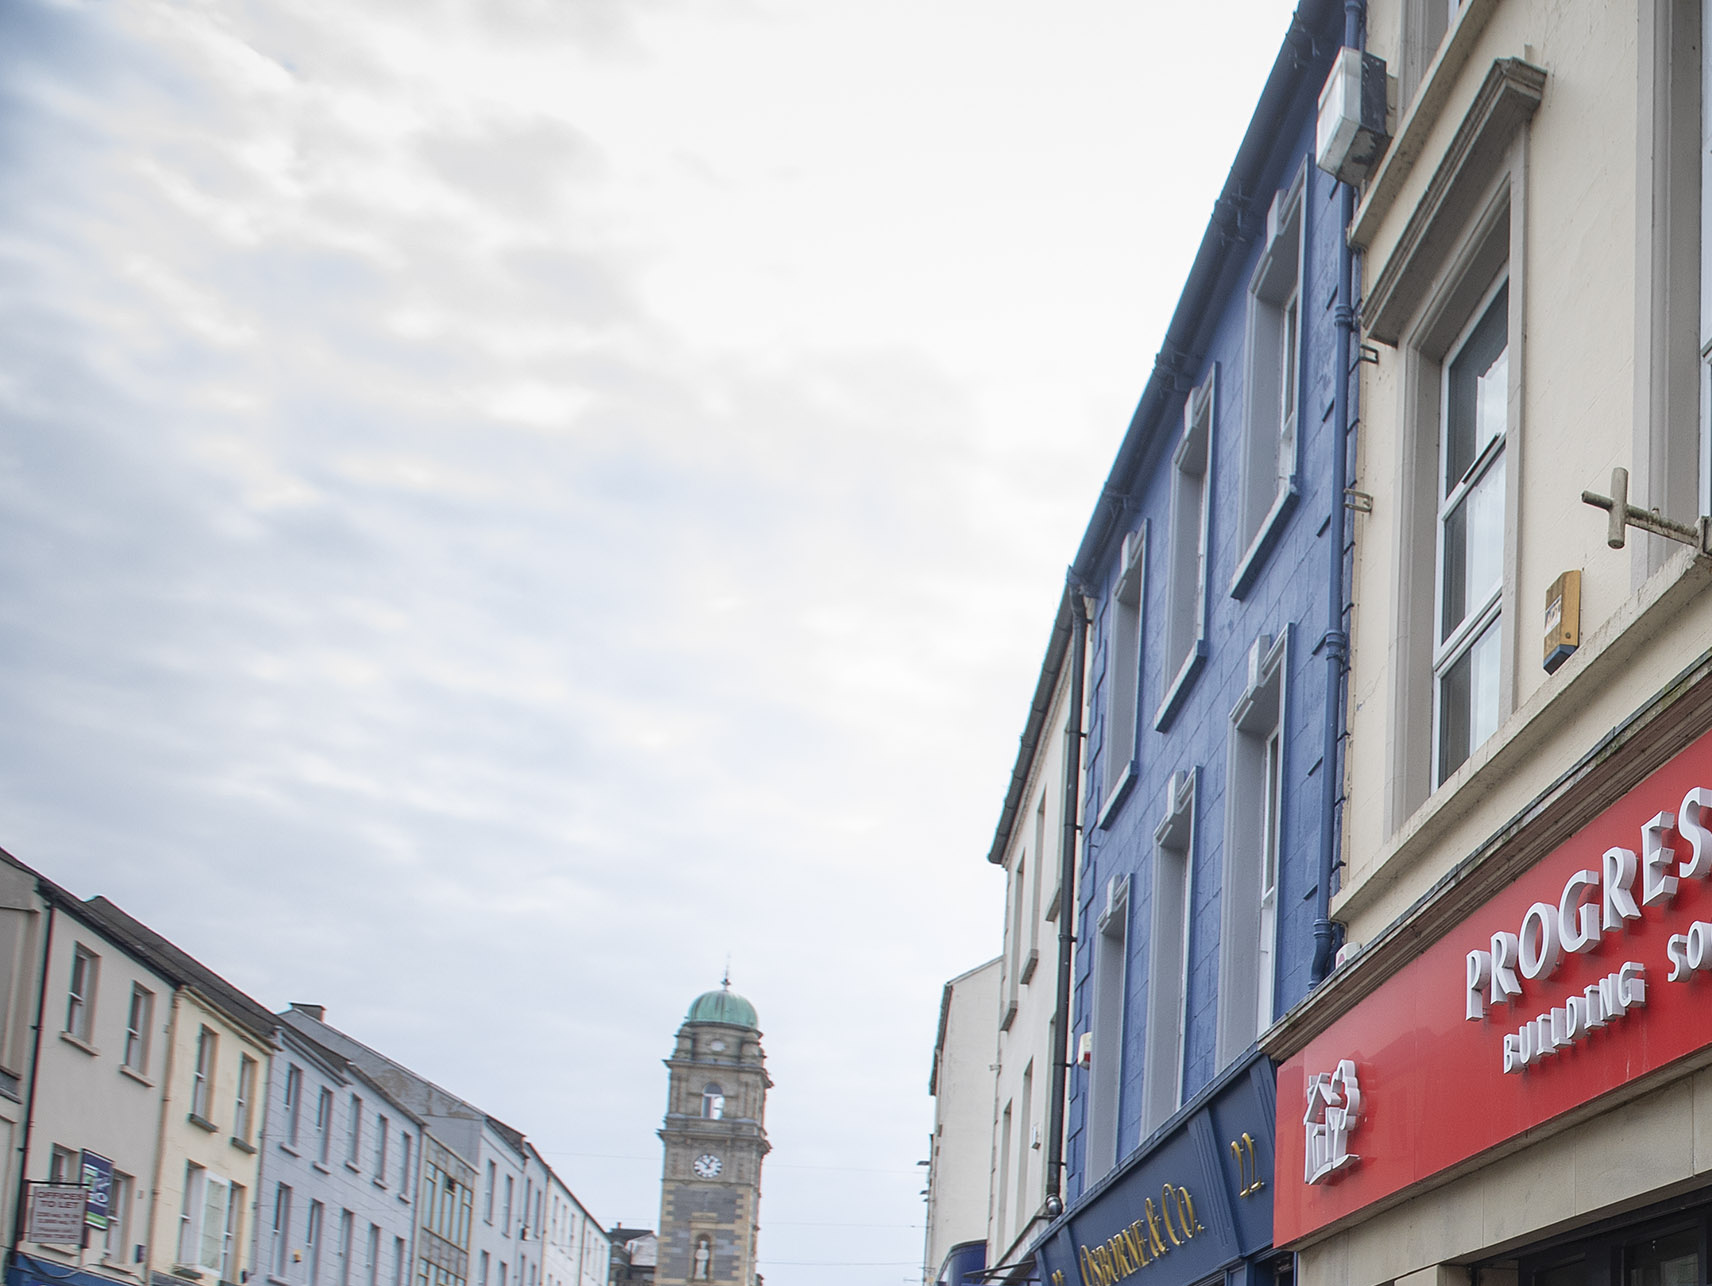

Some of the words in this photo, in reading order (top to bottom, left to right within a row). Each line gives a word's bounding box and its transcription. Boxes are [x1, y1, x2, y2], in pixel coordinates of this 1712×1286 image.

[1503, 961, 1646, 1074] BUILDING
[37, 1191, 84, 1202] OFFICES
[1146, 1197, 1168, 1258] &
